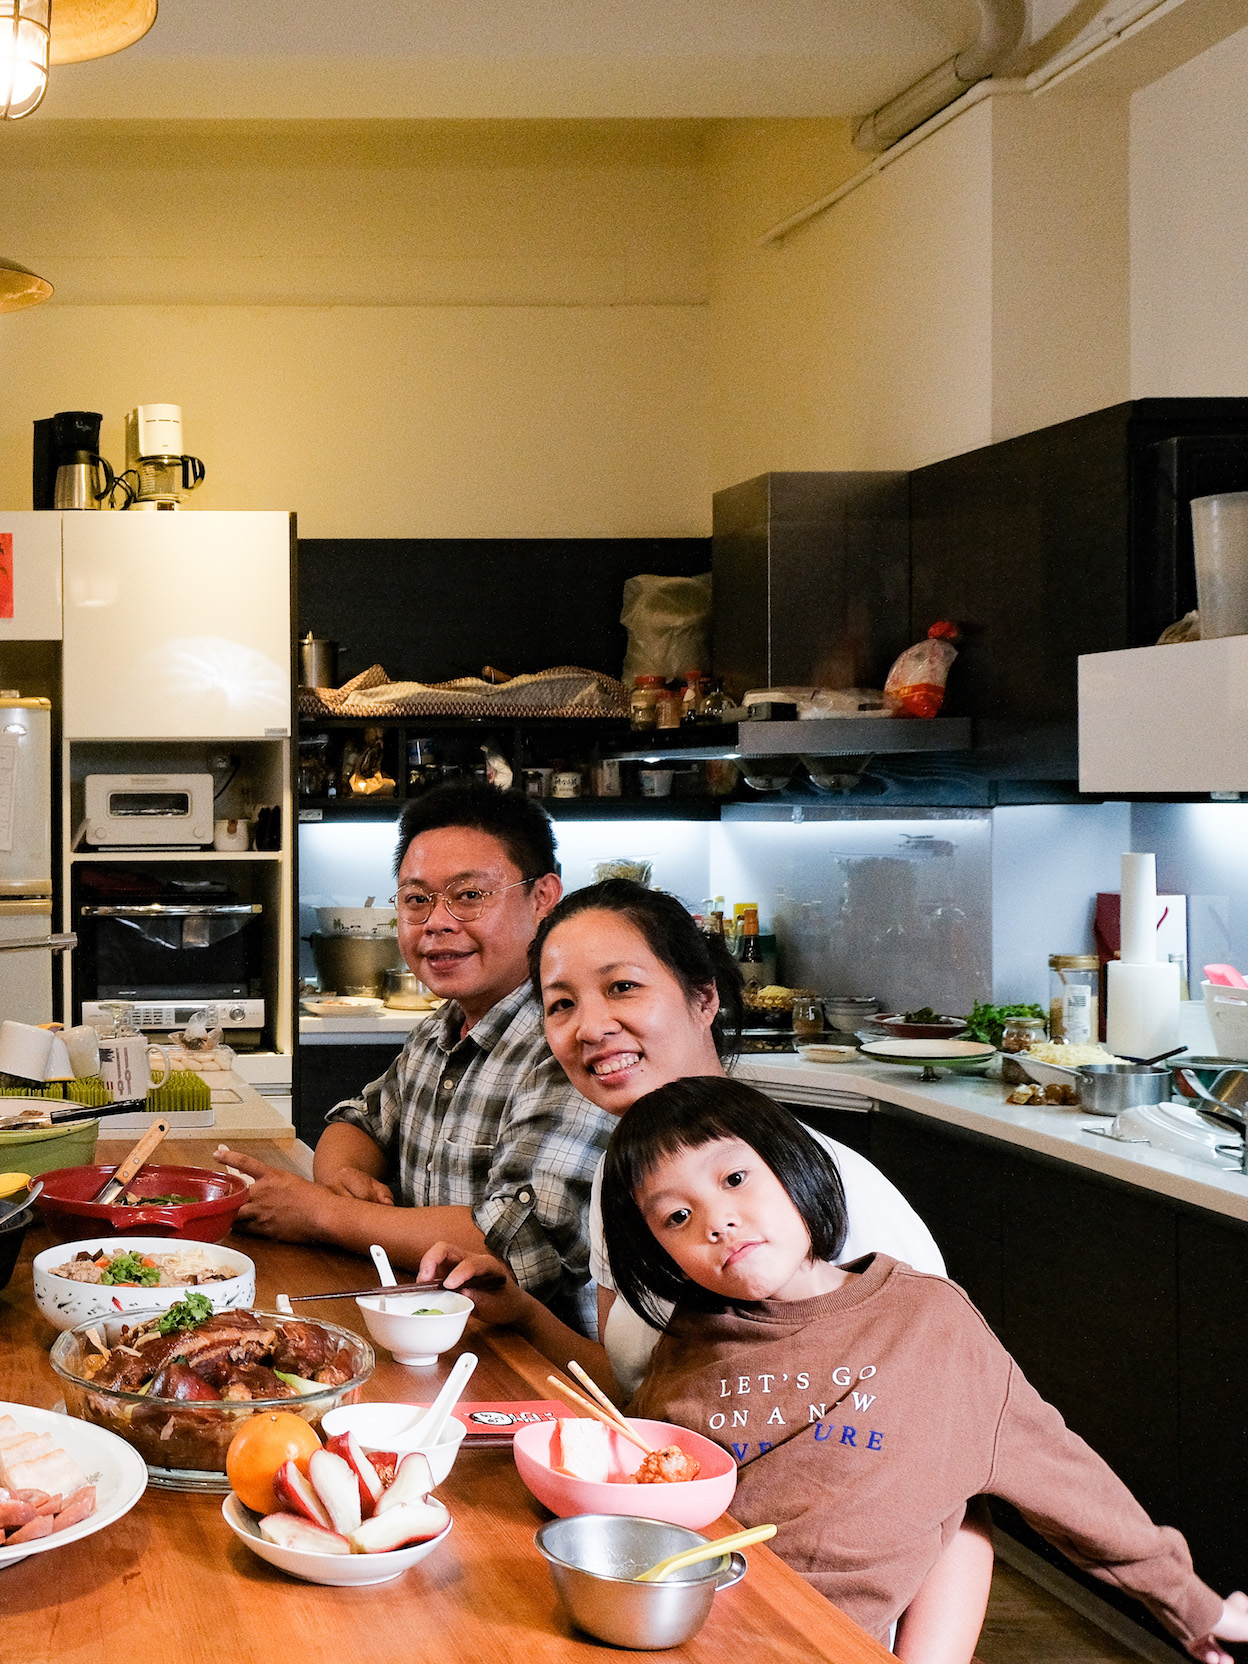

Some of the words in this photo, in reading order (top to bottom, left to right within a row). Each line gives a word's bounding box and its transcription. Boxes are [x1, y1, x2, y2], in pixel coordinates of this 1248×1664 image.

[720, 1372, 810, 1398] LET'S
[832, 1365, 877, 1386] GO
[709, 1409, 749, 1430] ON
[767, 1406, 786, 1424] A
[808, 1391, 877, 1423] NW
